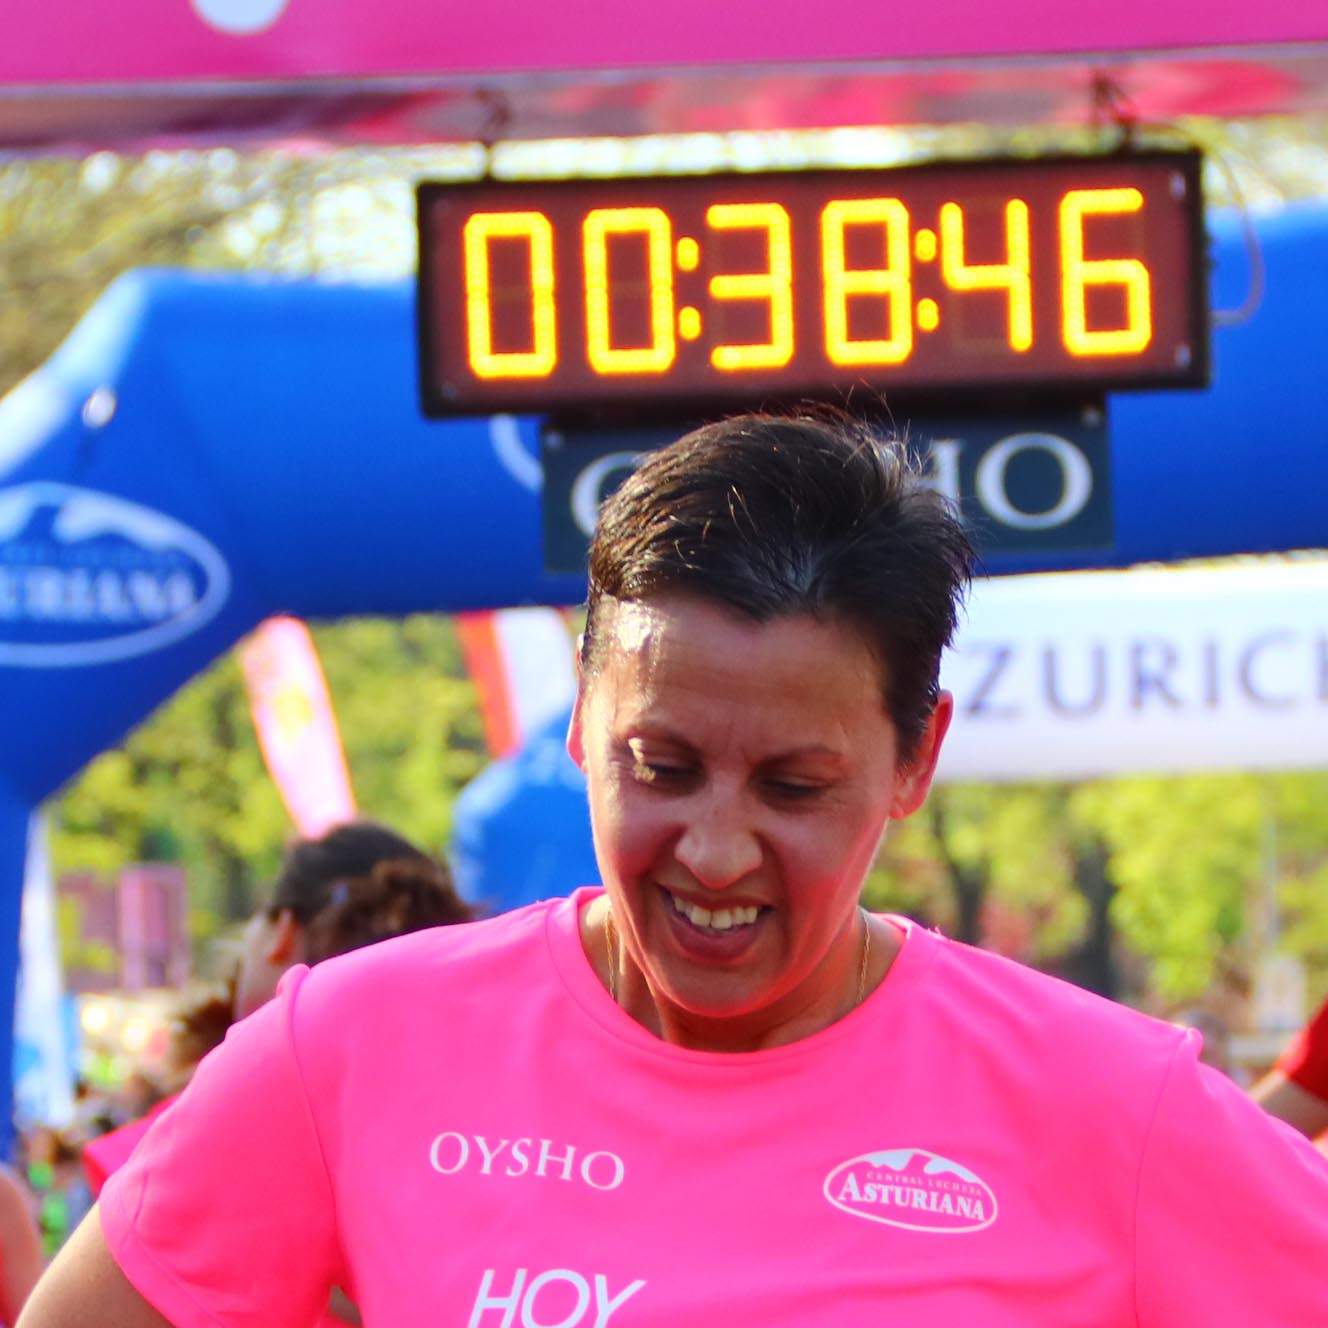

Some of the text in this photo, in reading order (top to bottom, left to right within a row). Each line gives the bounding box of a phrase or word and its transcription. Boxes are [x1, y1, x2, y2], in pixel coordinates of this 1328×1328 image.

[463, 187, 1154, 379] 00:38:46
[428, 1130, 626, 1191] OYSHO
[837, 1172, 985, 1222] ASTURIANA
